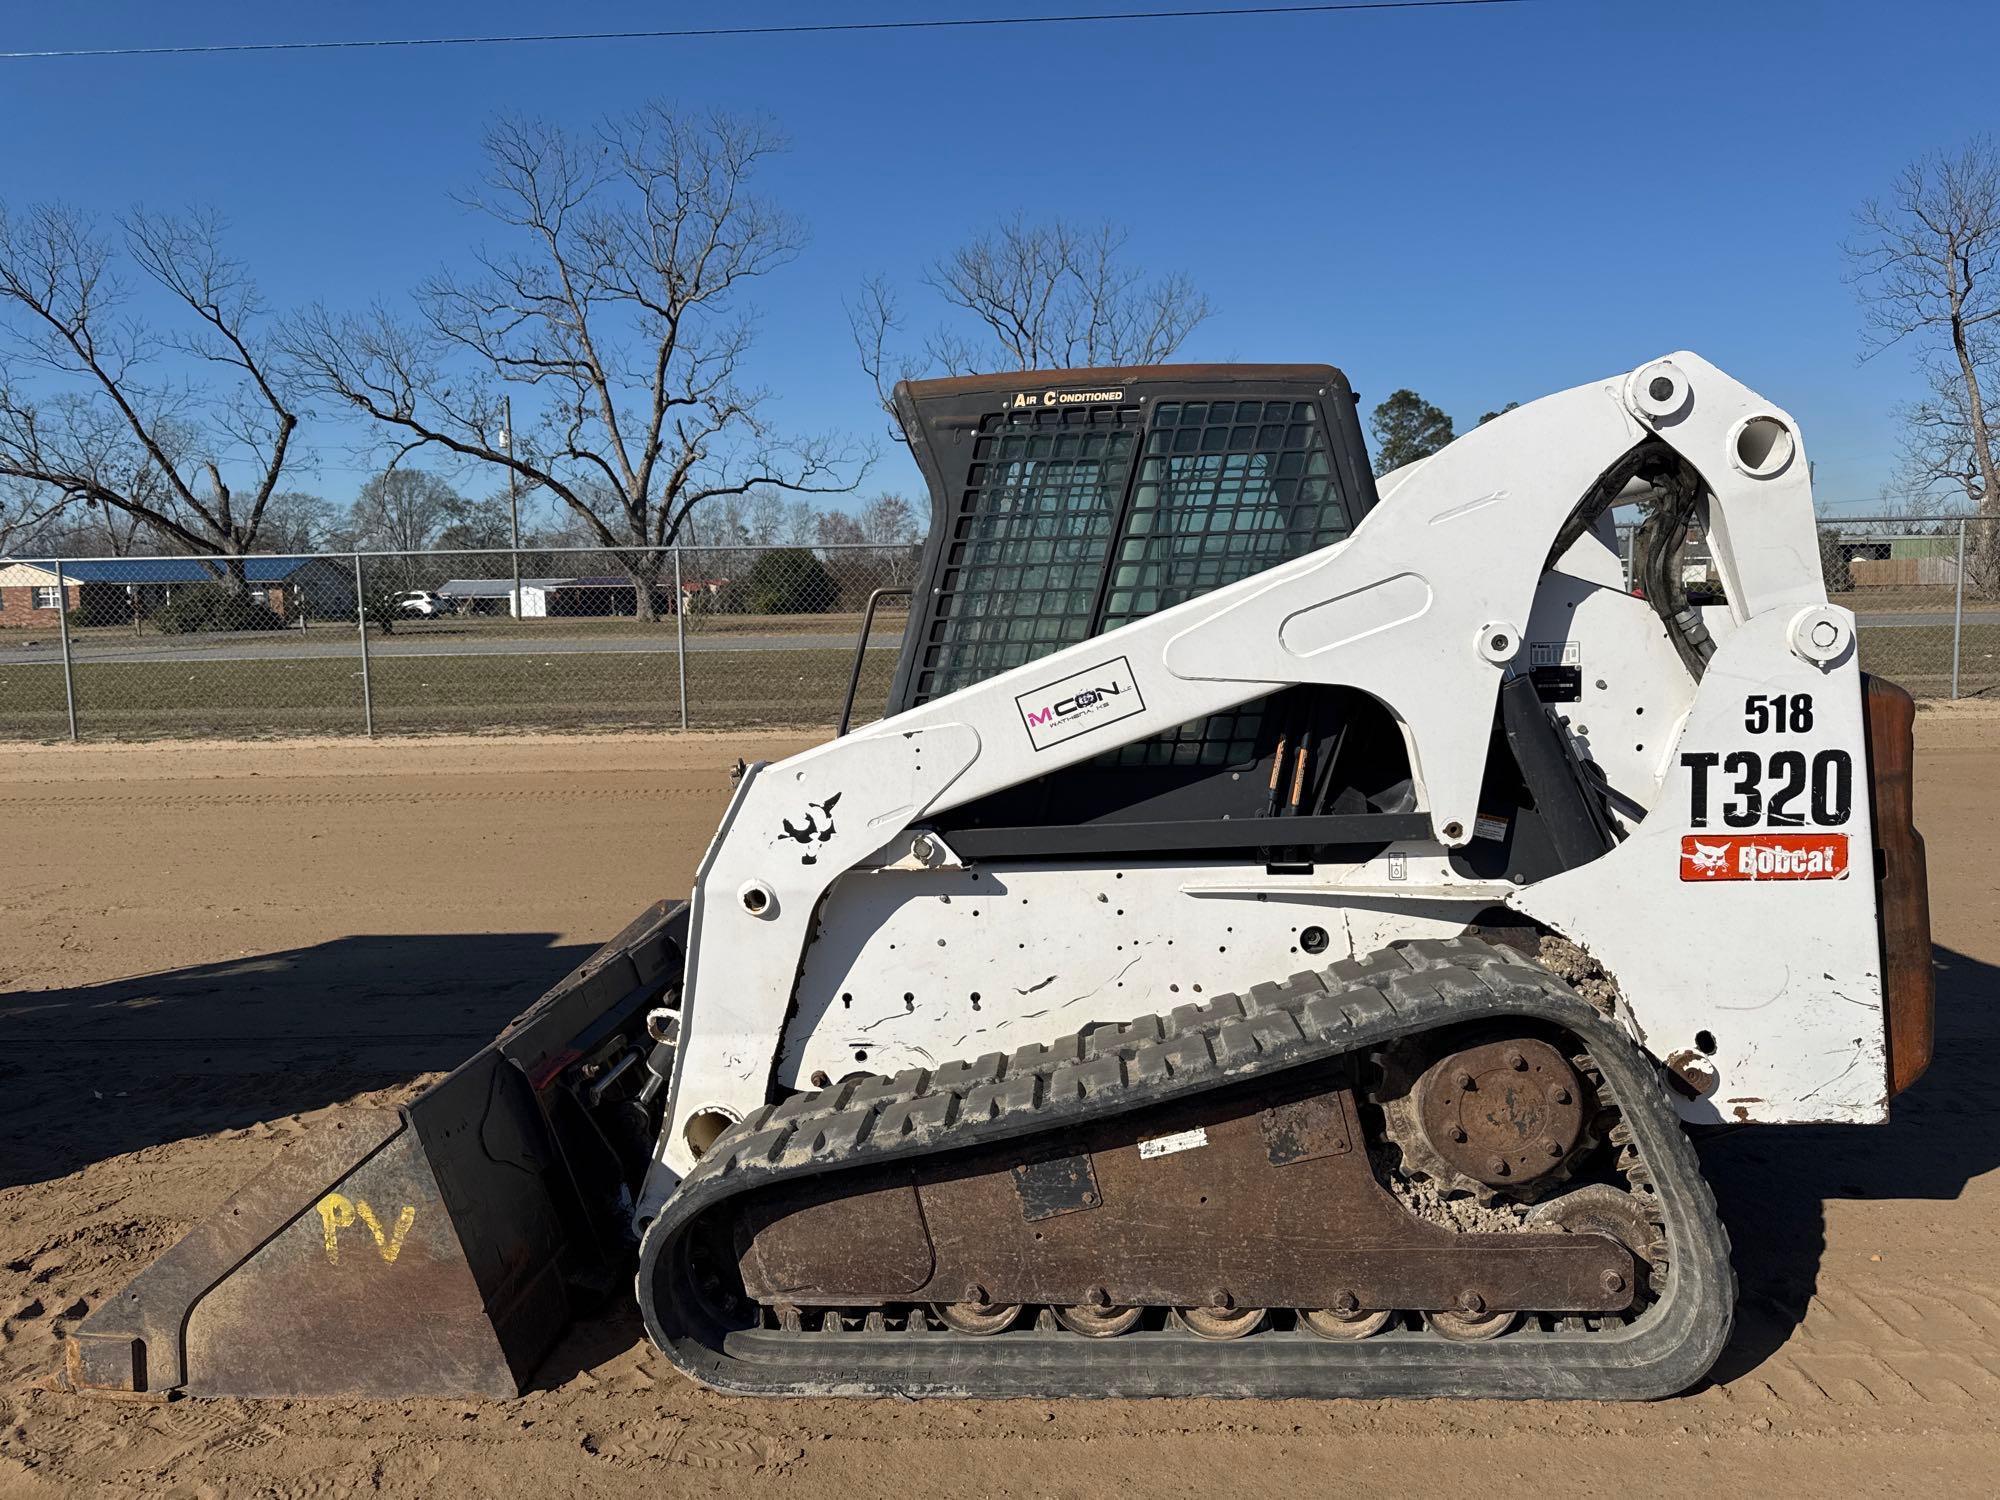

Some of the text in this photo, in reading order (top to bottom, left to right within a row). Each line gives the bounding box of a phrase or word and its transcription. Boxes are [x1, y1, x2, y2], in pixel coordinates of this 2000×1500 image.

[1745, 693, 1814, 734] 518
[1680, 749, 1852, 828] T320
[1738, 845, 1834, 874] Bobcat
[317, 1193, 416, 1265] PV
